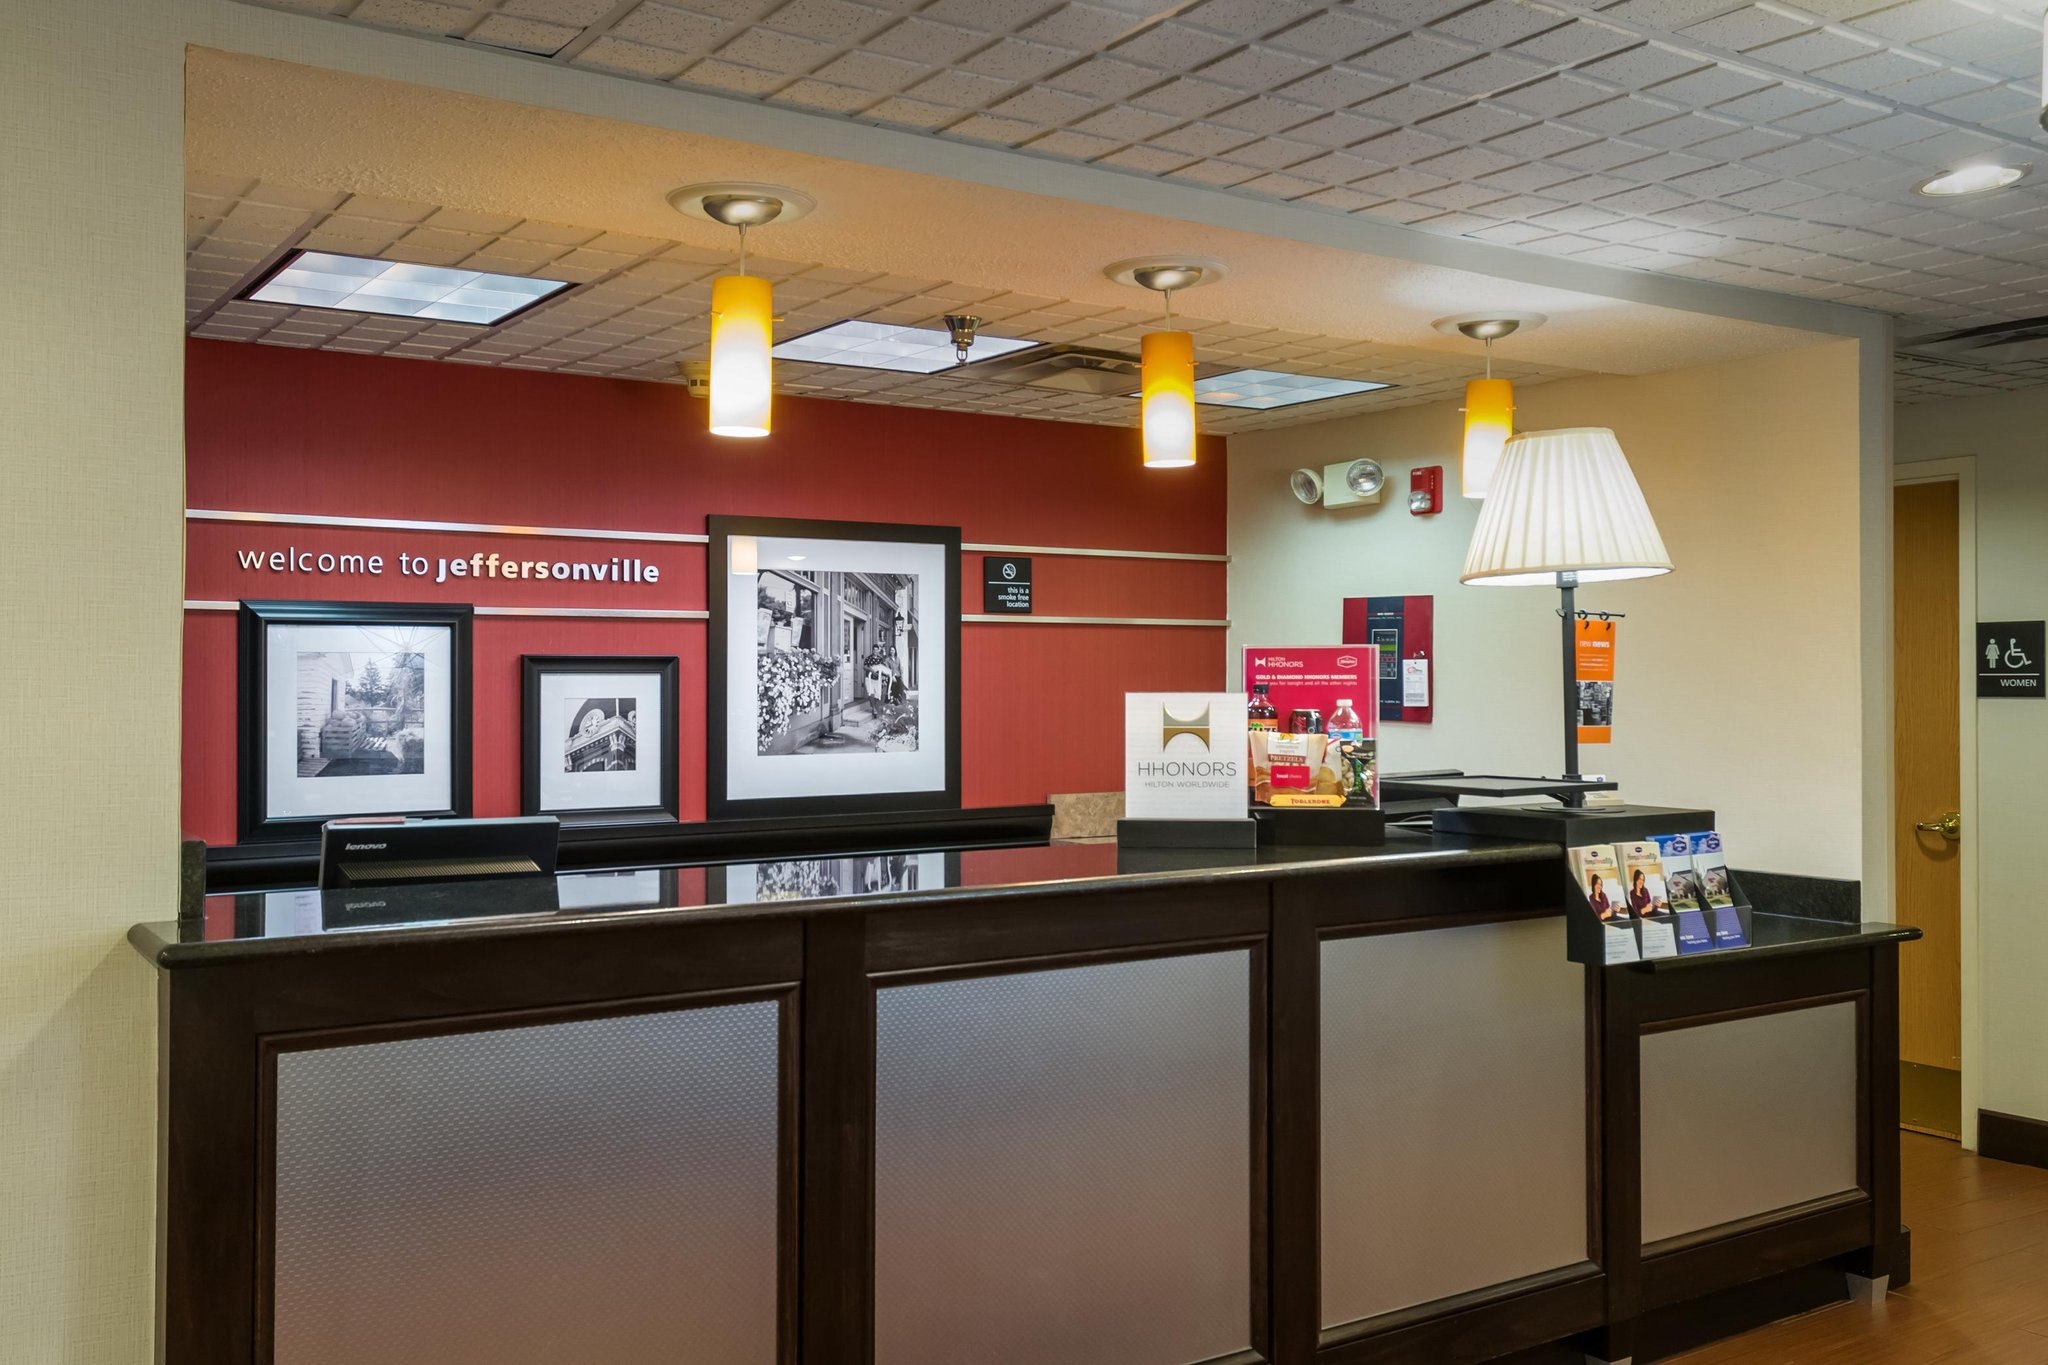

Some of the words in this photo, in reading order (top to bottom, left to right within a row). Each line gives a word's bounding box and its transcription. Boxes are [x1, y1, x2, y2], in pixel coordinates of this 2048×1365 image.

[238, 547, 383, 575] welcome
[400, 554, 428, 576] to
[1006, 600, 1029, 608] location
[1268, 660, 1304, 668] HHONORS
[1269, 754, 1304, 763] PRETZELS
[1138, 761, 1237, 777] HHONORS
